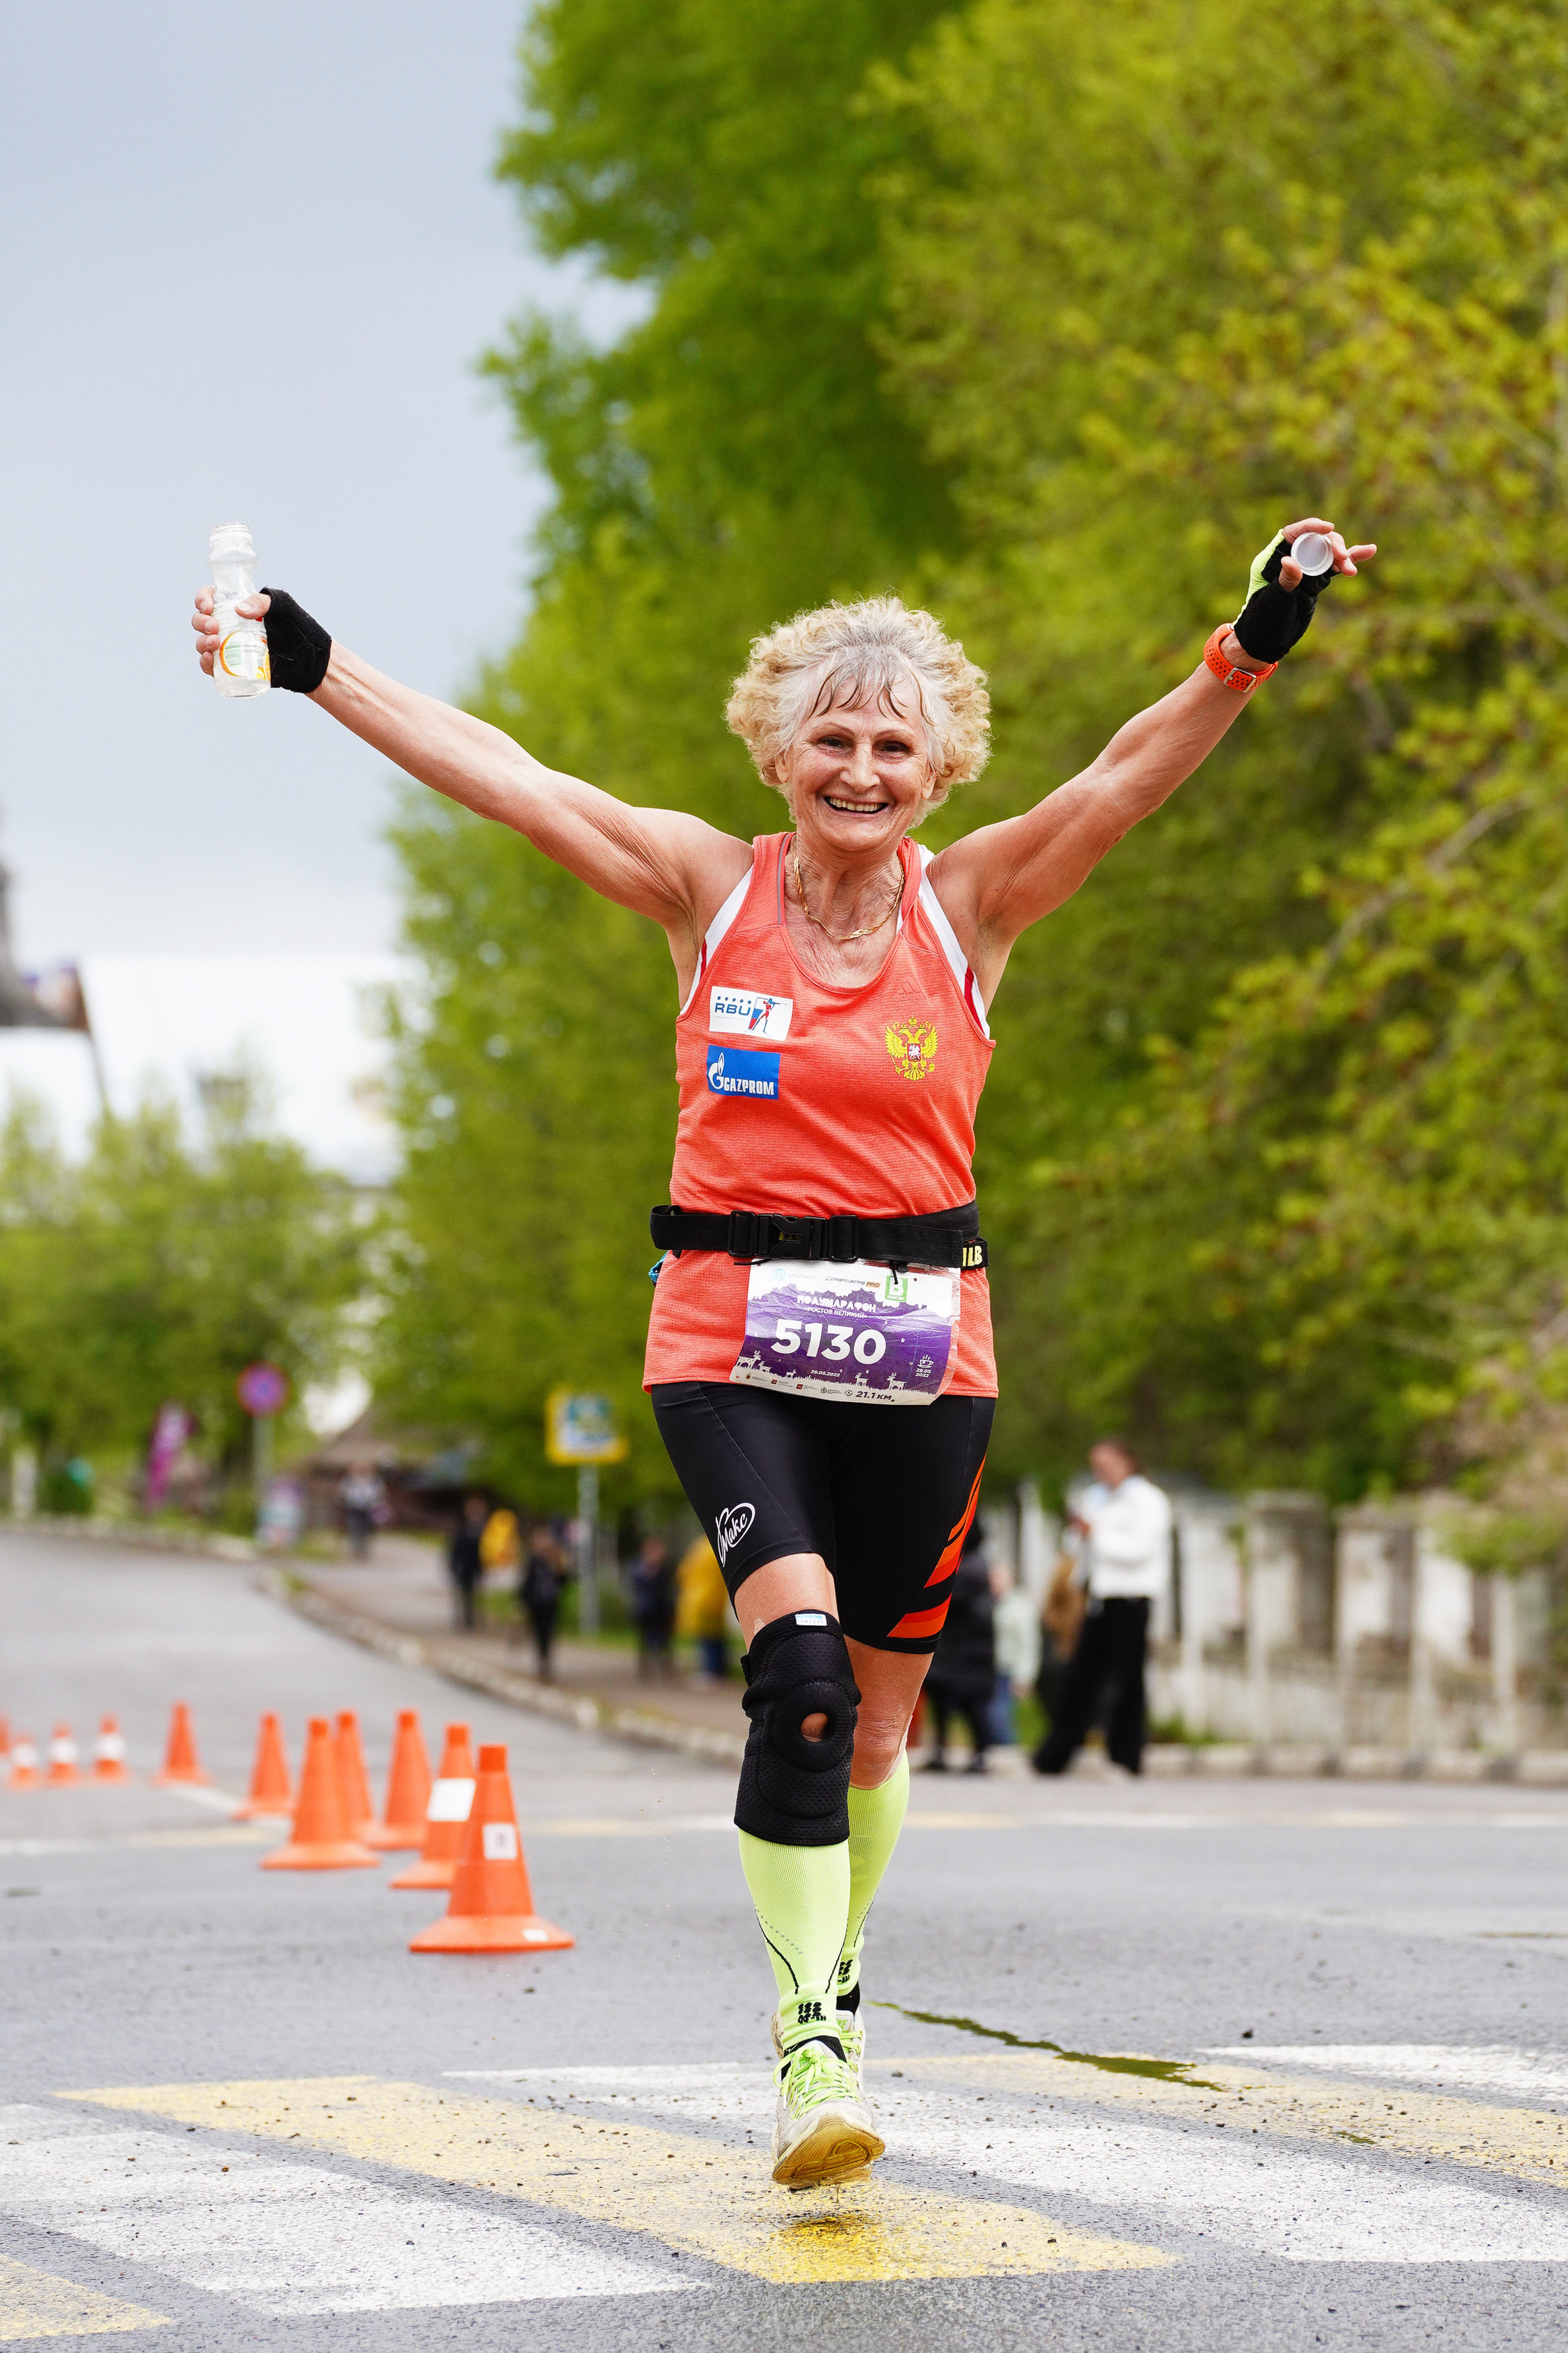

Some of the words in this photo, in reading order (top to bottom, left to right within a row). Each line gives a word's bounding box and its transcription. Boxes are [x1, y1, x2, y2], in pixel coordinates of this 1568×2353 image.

[715, 1002, 751, 1016] RBU
[723, 1076, 774, 1095] GAZPROM
[797, 1294, 876, 1313] ПОЛУМАРАФОН
[771, 1318, 886, 1365] 5130
[810, 1369, 841, 1378] 29.05.2022
